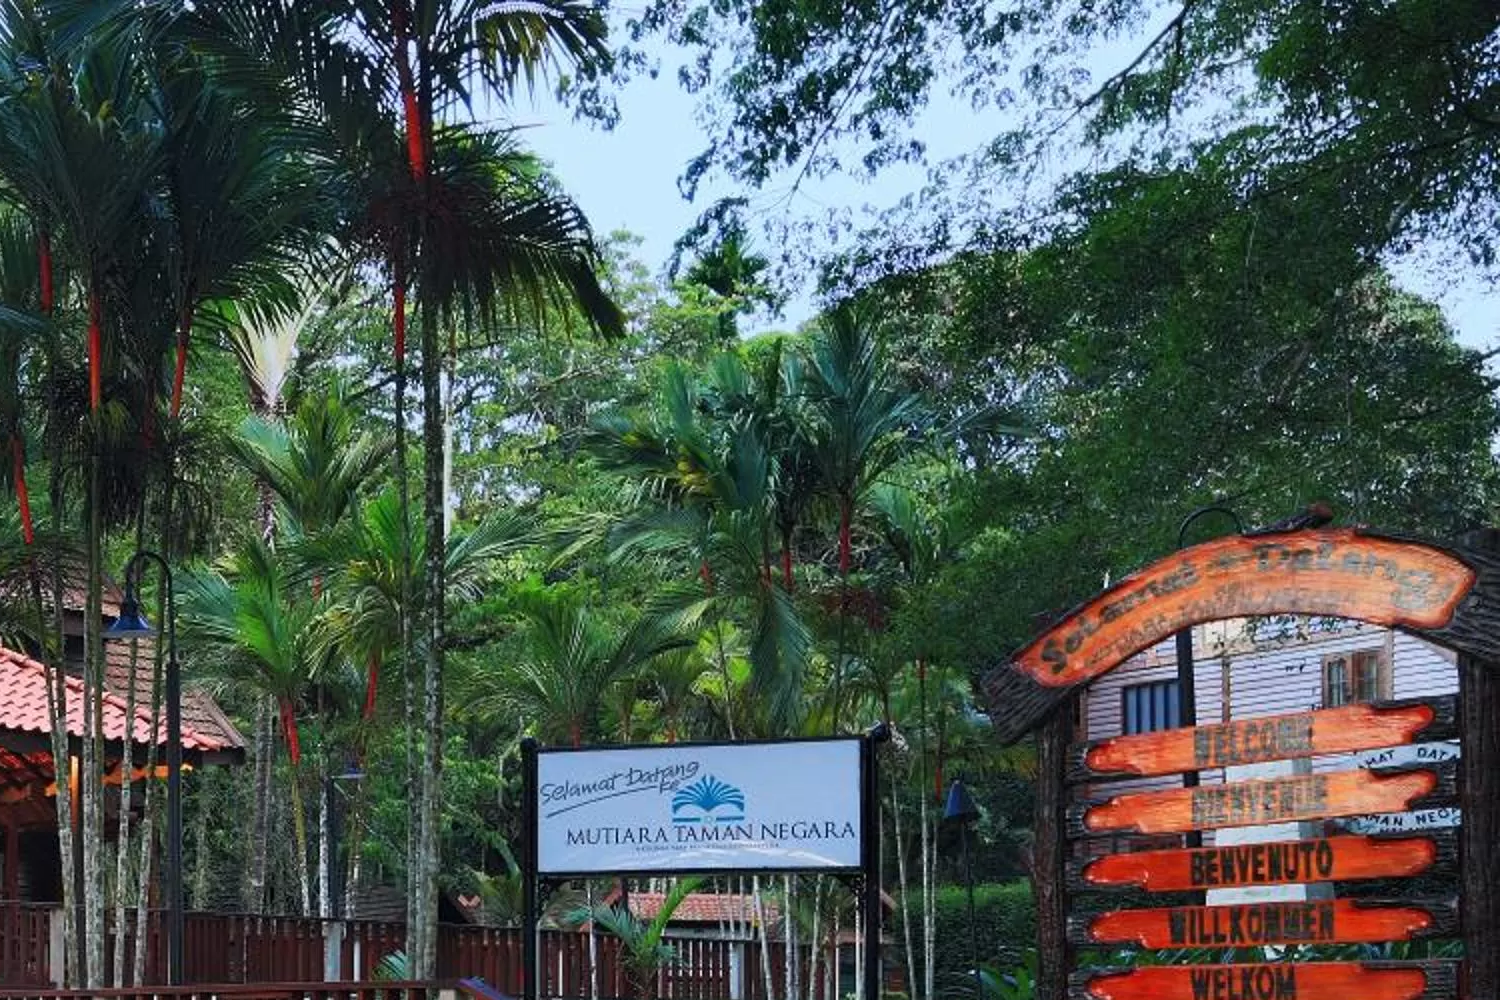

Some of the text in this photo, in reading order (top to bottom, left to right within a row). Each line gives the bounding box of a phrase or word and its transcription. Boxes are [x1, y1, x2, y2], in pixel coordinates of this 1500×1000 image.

[1195, 716, 1315, 768] WELCOME
[540, 761, 699, 804] Selamat Datang
[567, 827, 668, 846] MUTIARA
[674, 824, 752, 843] TAMAN
[761, 821, 855, 840] NEGARA
[1191, 840, 1333, 885] BENVENUTO
[1169, 901, 1335, 945] WILLKOMMEN
